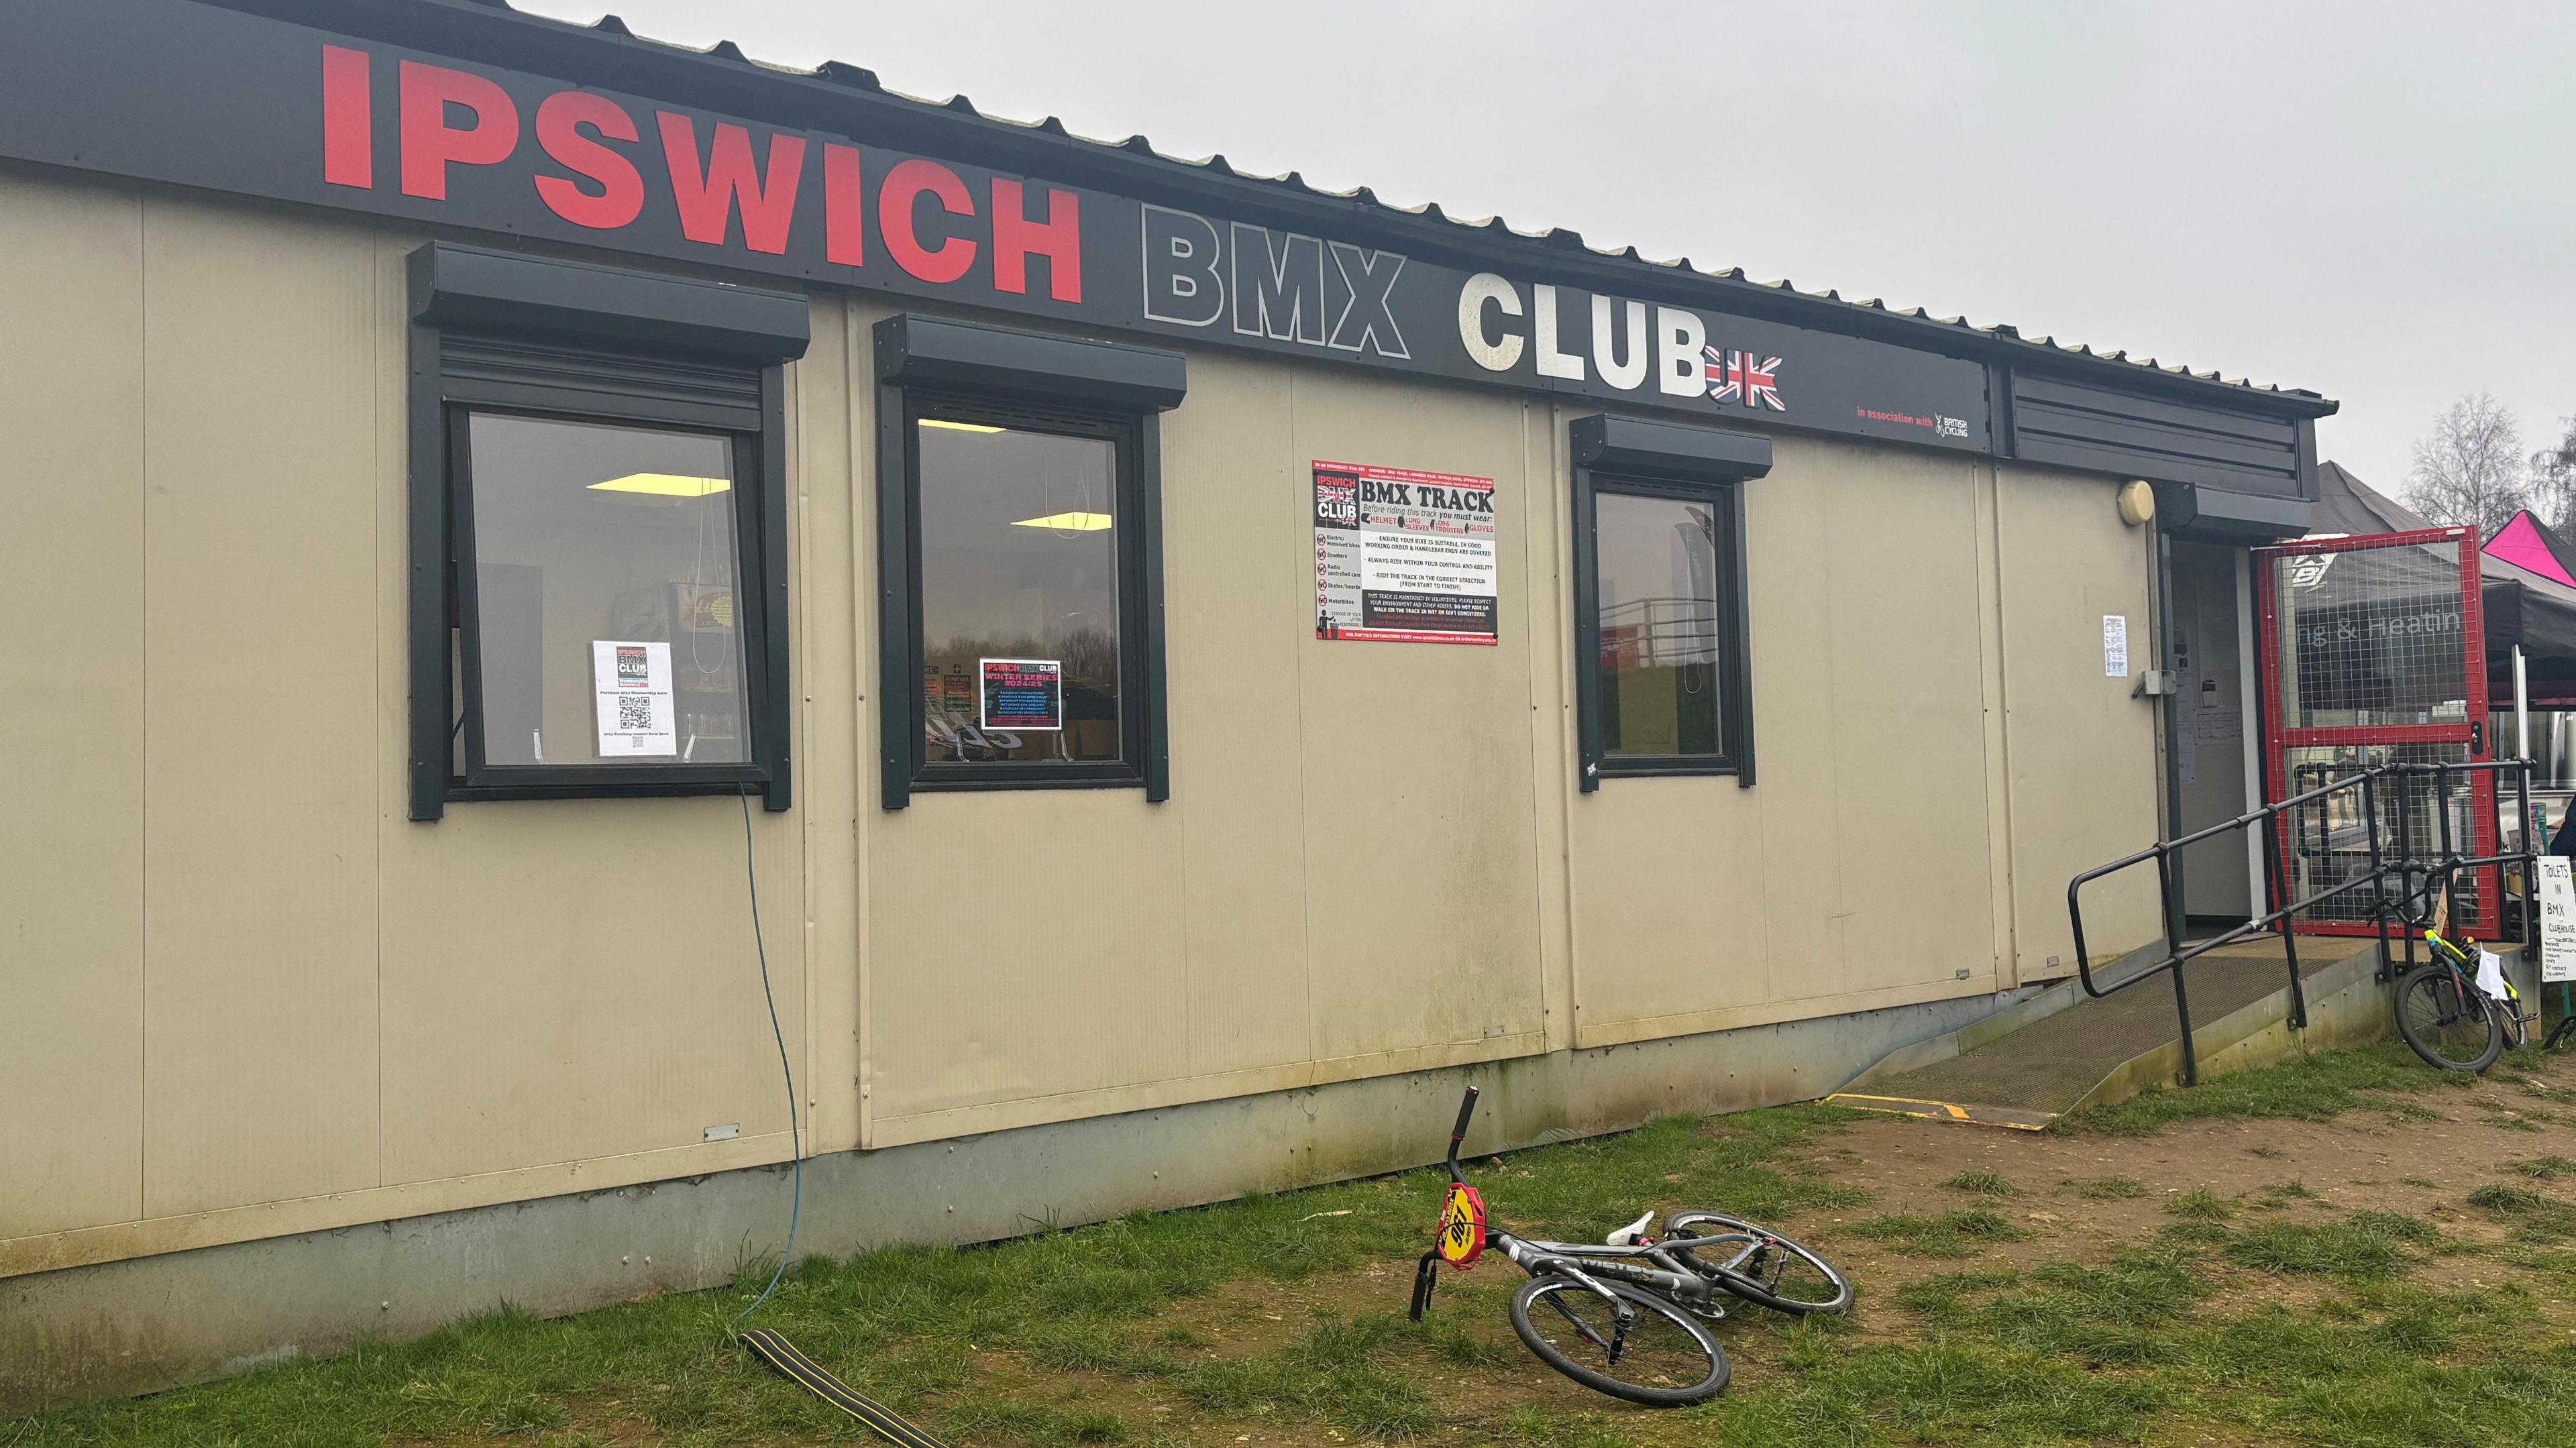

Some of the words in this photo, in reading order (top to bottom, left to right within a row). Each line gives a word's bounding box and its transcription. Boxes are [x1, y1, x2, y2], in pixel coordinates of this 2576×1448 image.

[322, 44, 1081, 304] IPSWICH
[1140, 203, 1411, 359] BMX
[1458, 272, 1708, 400] CLUB
[1705, 345, 1786, 413] UK
[1857, 406, 1865, 417] in
[1867, 409, 1913, 425] association
[1916, 414, 1933, 427] with
[1944, 417, 1968, 429] BRITISH
[1945, 427, 1968, 437] CYCLING
[1318, 476, 1356, 488] IPSWICH
[1360, 480, 1411, 506] BMX
[1417, 486, 1494, 513] TRACK
[1318, 503, 1356, 518] CLUB
[1363, 504, 1385, 513] Before
[1387, 506, 1405, 516] riding
[1407, 508, 1419, 516] this
[1421, 510, 1437, 518] track
[1371, 516, 1397, 524] HELMET
[1405, 523, 1430, 531] SLEEVES
[1469, 524, 1494, 533] GLOVES
[618, 655, 647, 665] BMX
[619, 664, 647, 673] CLUB
[985, 663, 1020, 672] IPSWICH
[2544, 864, 2569, 879] TOILETS
[2555, 883, 2561, 895] IN
[2547, 903, 2565, 917] BMX
[2548, 923, 2576, 934] CLUBHOUSE
[1451, 1204, 1467, 1248] 961
